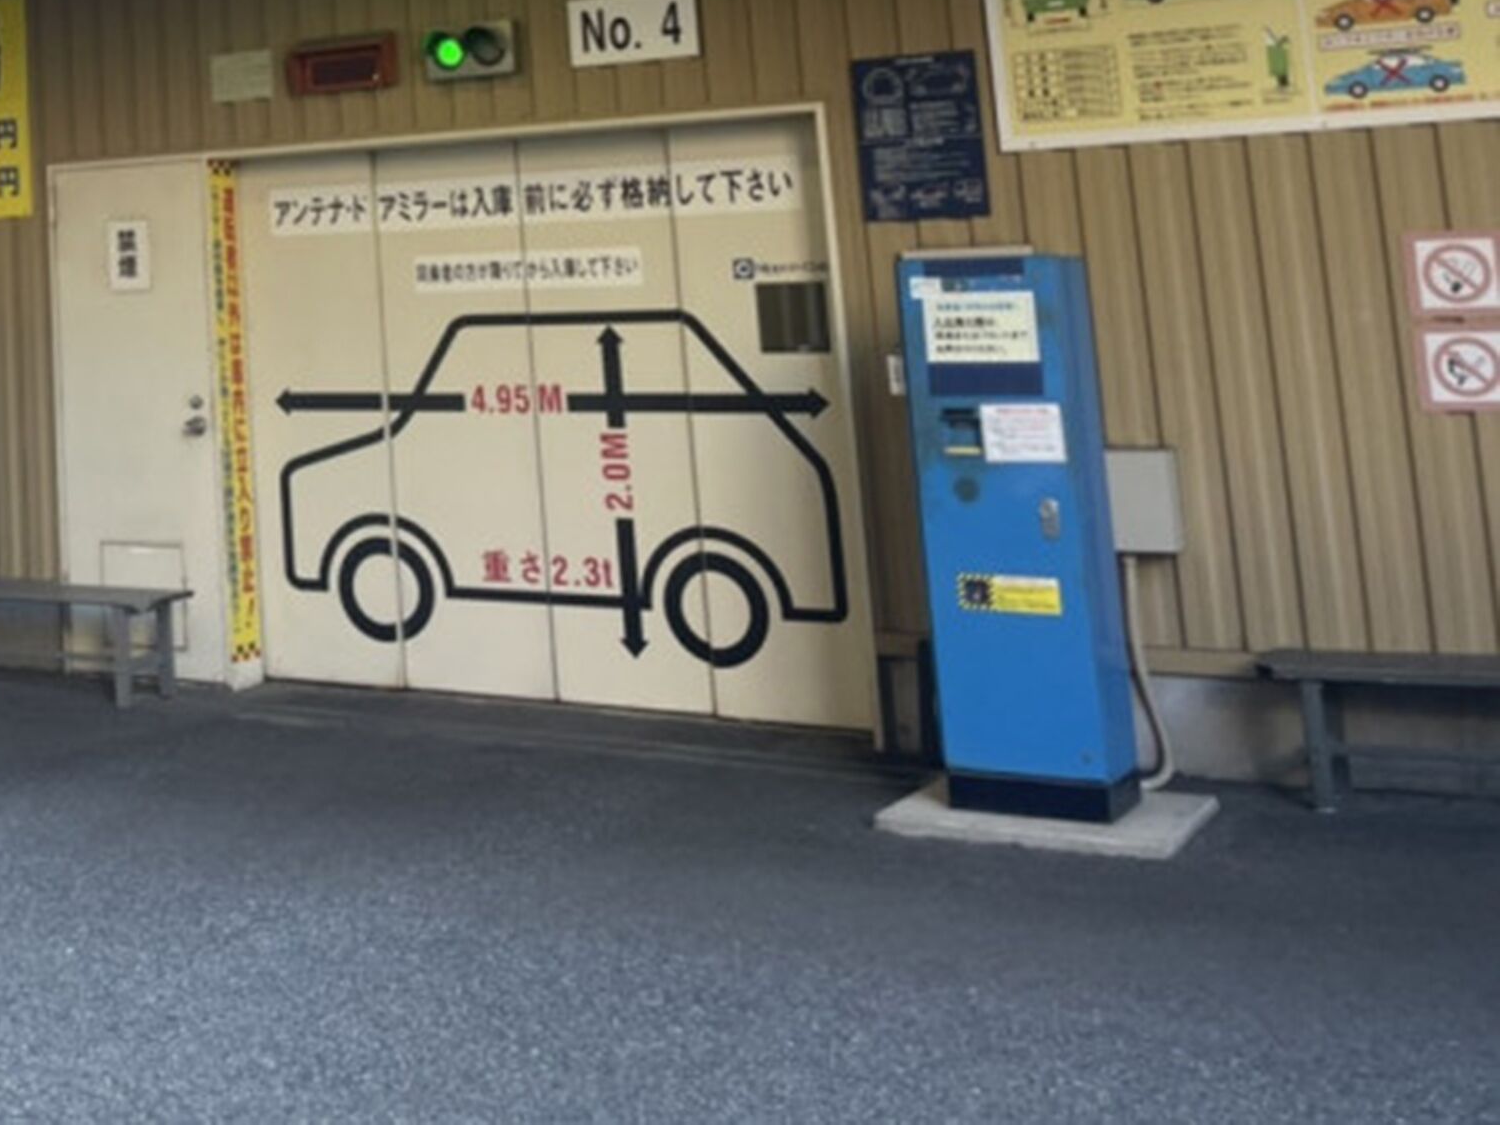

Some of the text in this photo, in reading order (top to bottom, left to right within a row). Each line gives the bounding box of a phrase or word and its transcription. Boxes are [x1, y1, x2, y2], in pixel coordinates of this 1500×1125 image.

[580, 0, 681, 53] No. 4
[599, 431, 635, 511] 2.0M
